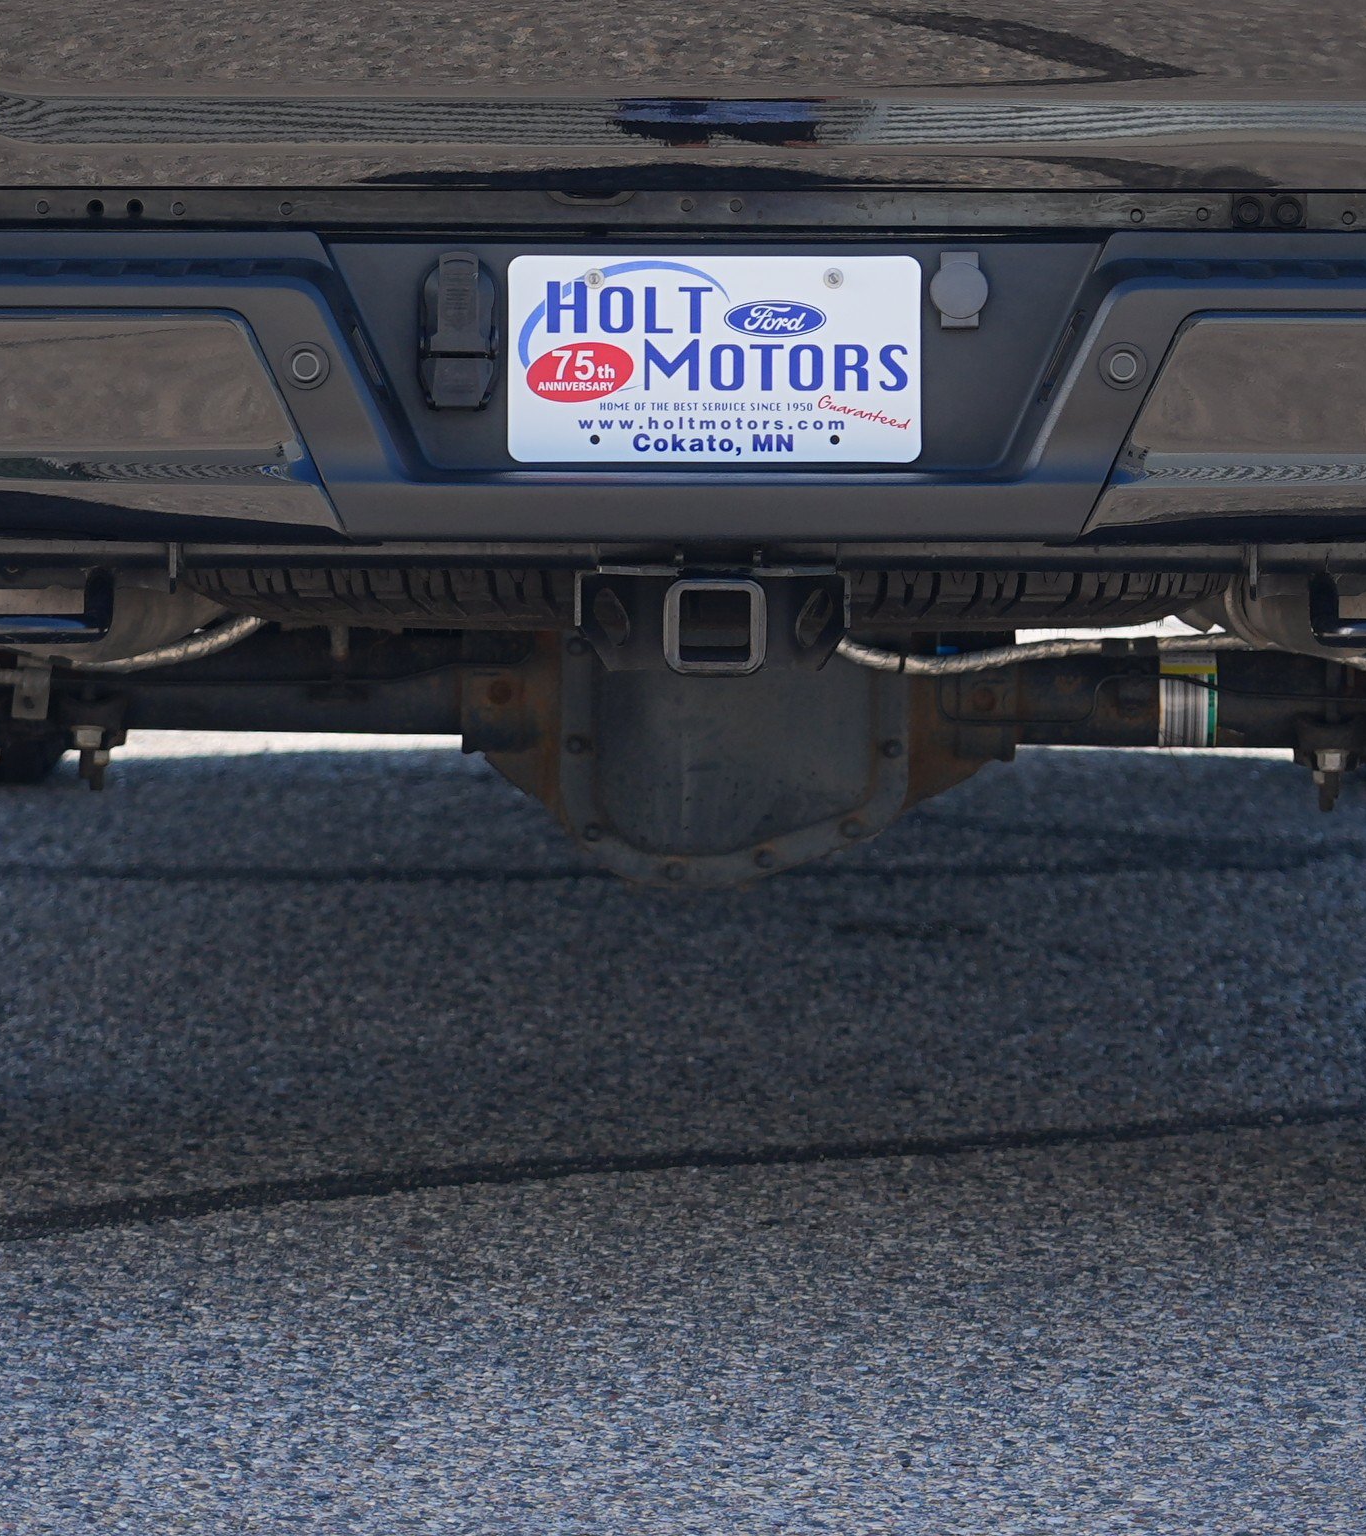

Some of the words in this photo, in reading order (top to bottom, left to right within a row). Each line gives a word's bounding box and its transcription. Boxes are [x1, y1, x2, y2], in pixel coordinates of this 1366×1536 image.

[547, 281, 713, 334] HOLT
[744, 305, 807, 332] Ford
[551, 350, 615, 381] 75th
[644, 338, 909, 391] MOTORS
[537, 381, 615, 392] ANNIVERSARY
[599, 402, 630, 411] HOME
[634, 402, 647, 411] OF
[651, 402, 669, 411] THE
[673, 402, 698, 411] BEST
[702, 402, 746, 411] SERVICE
[750, 402, 782, 411] SINCE
[786, 402, 813, 411] 1950
[817, 394, 911, 430] Guaranteed
[578, 416, 845, 430] www.holtmotors.com
[633, 433, 742, 456] Cokato,
[752, 434, 794, 452] MN
